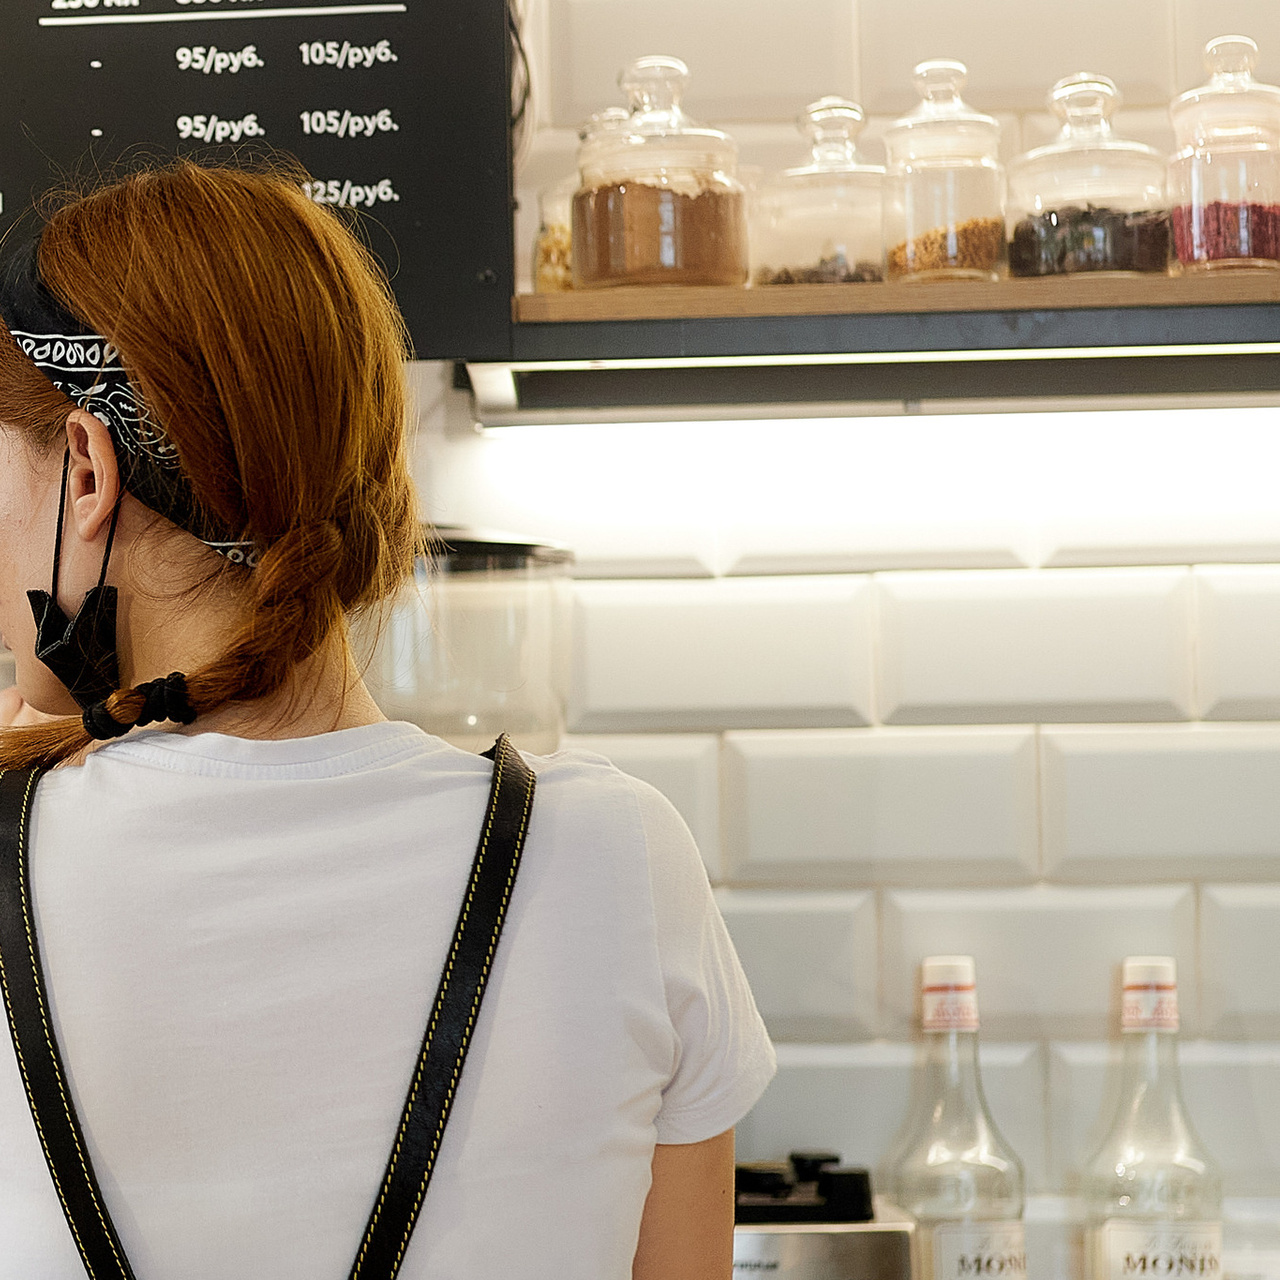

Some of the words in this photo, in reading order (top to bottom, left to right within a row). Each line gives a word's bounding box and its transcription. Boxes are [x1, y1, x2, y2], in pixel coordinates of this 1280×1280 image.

[176, 45, 264, 73] 95/руб.
[299, 40, 397, 68] 105/руб.
[177, 114, 265, 142] 95/руб.
[300, 109, 399, 137] 105/руб.
